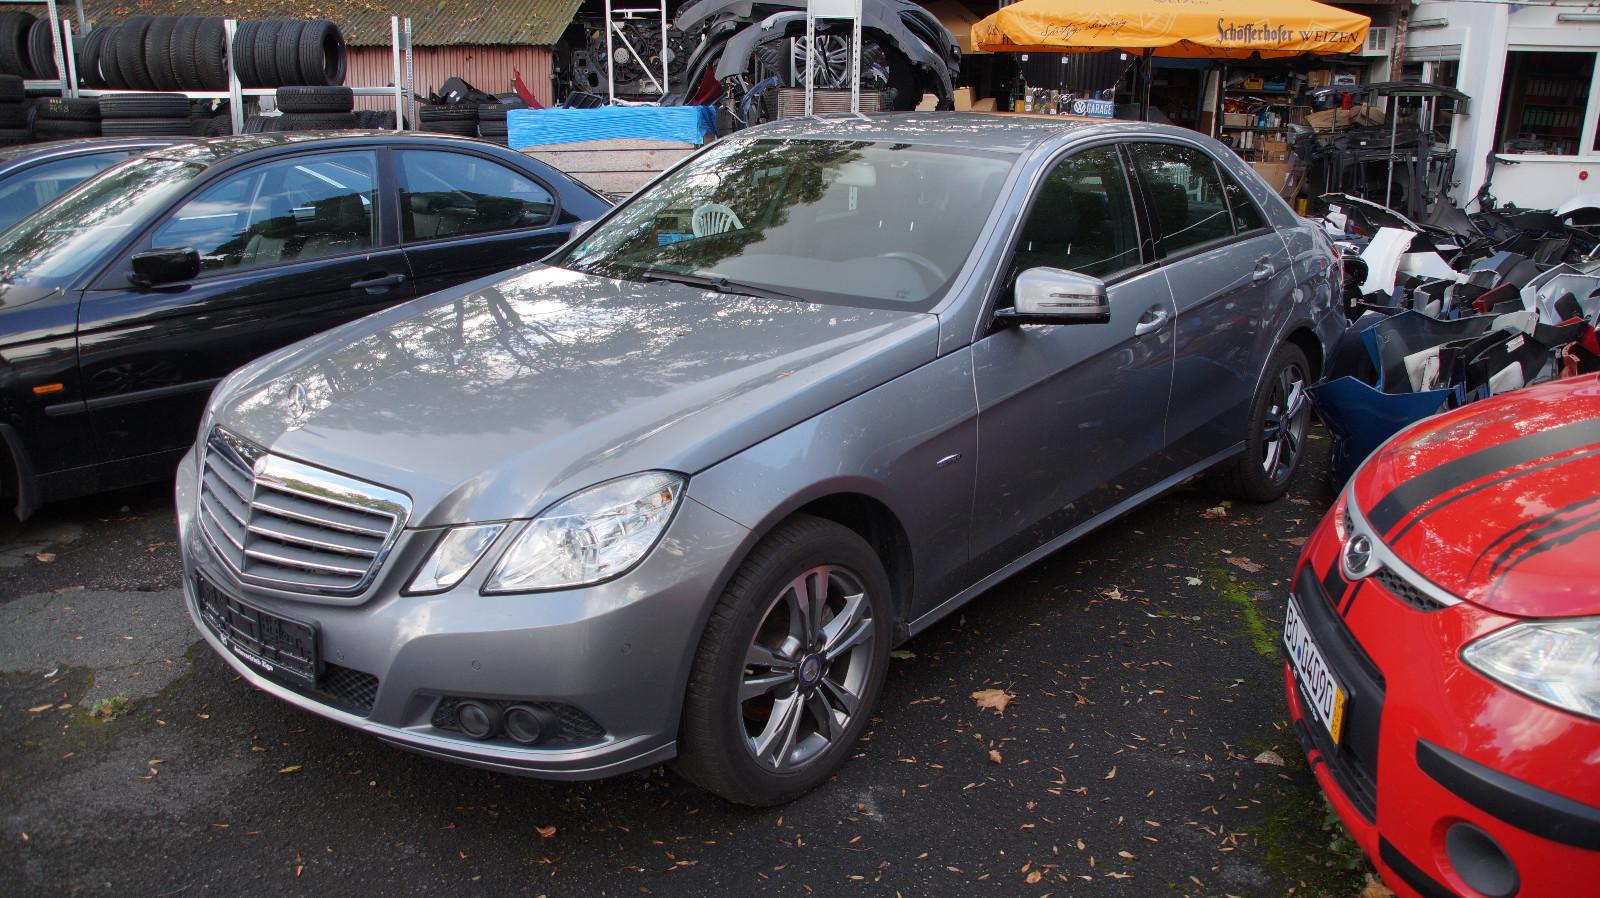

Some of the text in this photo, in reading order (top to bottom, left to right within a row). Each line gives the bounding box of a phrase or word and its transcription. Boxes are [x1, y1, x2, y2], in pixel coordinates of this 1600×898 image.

[1216, 17, 1359, 45] Schöfferhofer WEIZEN
[1086, 103, 1112, 115] GARAGE
[1300, 636, 1333, 721] 04090
